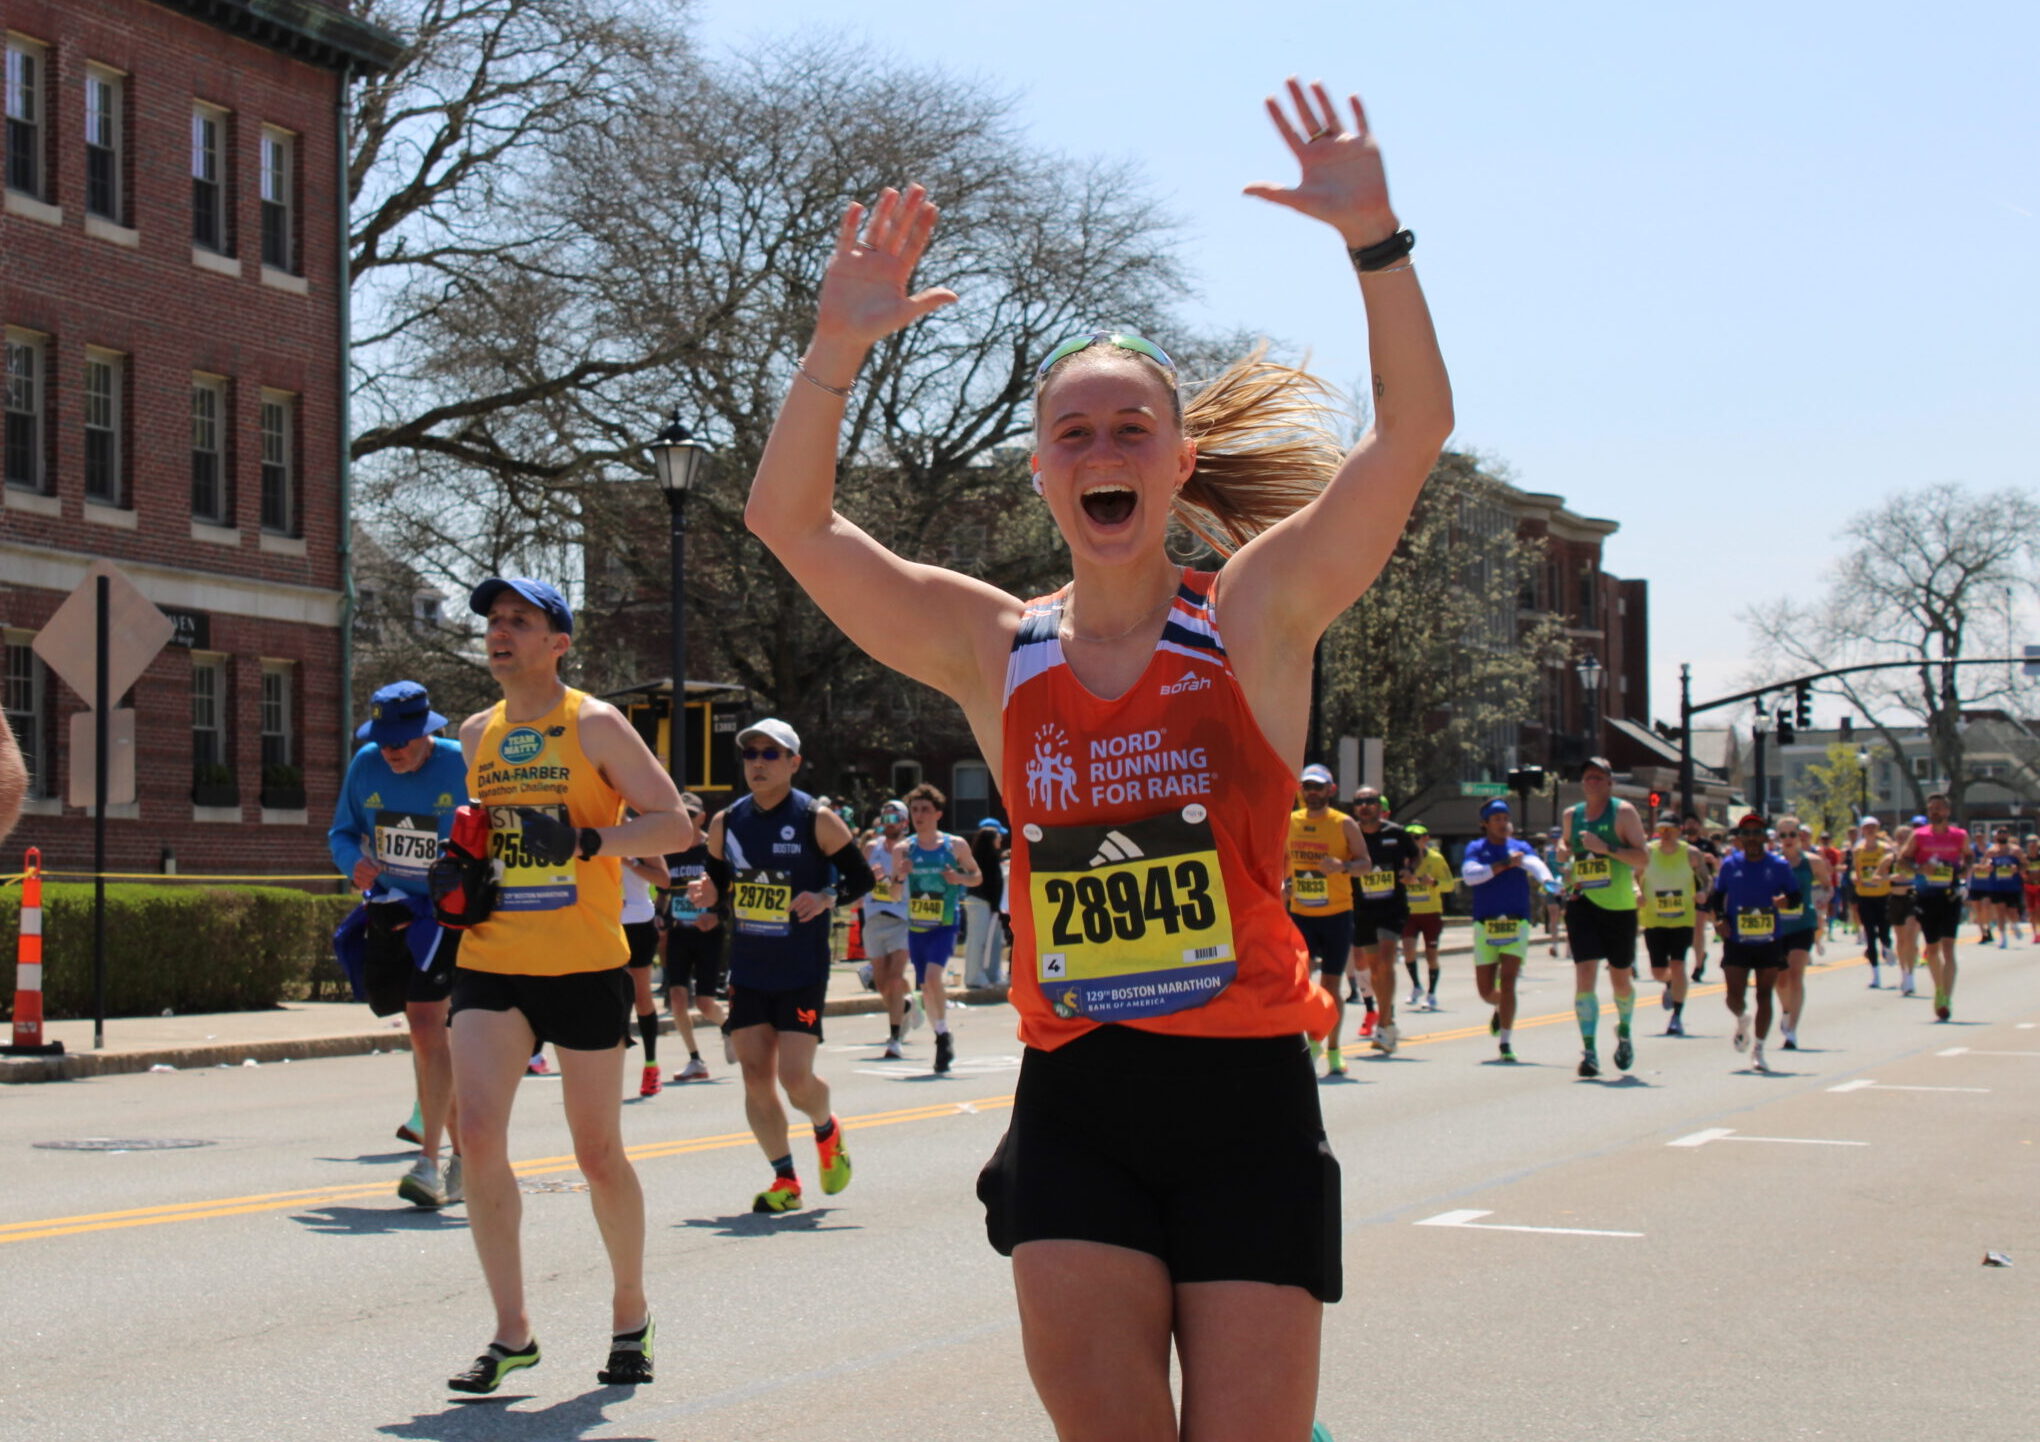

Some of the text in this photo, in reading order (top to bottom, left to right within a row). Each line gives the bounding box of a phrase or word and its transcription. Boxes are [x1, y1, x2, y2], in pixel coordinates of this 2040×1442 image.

[504, 743, 539, 755] MATTY
[508, 735, 536, 747] TEAM
[1090, 747, 1207, 783] RUNNING
[478, 766, 569, 788] DANA-FARBER
[1092, 779, 1142, 807] FOR
[385, 833, 437, 860] 16758
[772, 842, 802, 854] BOSTON
[738, 884, 787, 911] 29762
[1044, 859, 1216, 947] 28943
[1047, 959, 1061, 973] 4
[1111, 983, 1156, 1001] BOSTON
[1158, 976, 1221, 995] MARATHON
[1088, 997, 1165, 1012] BANK OF AMERICA
